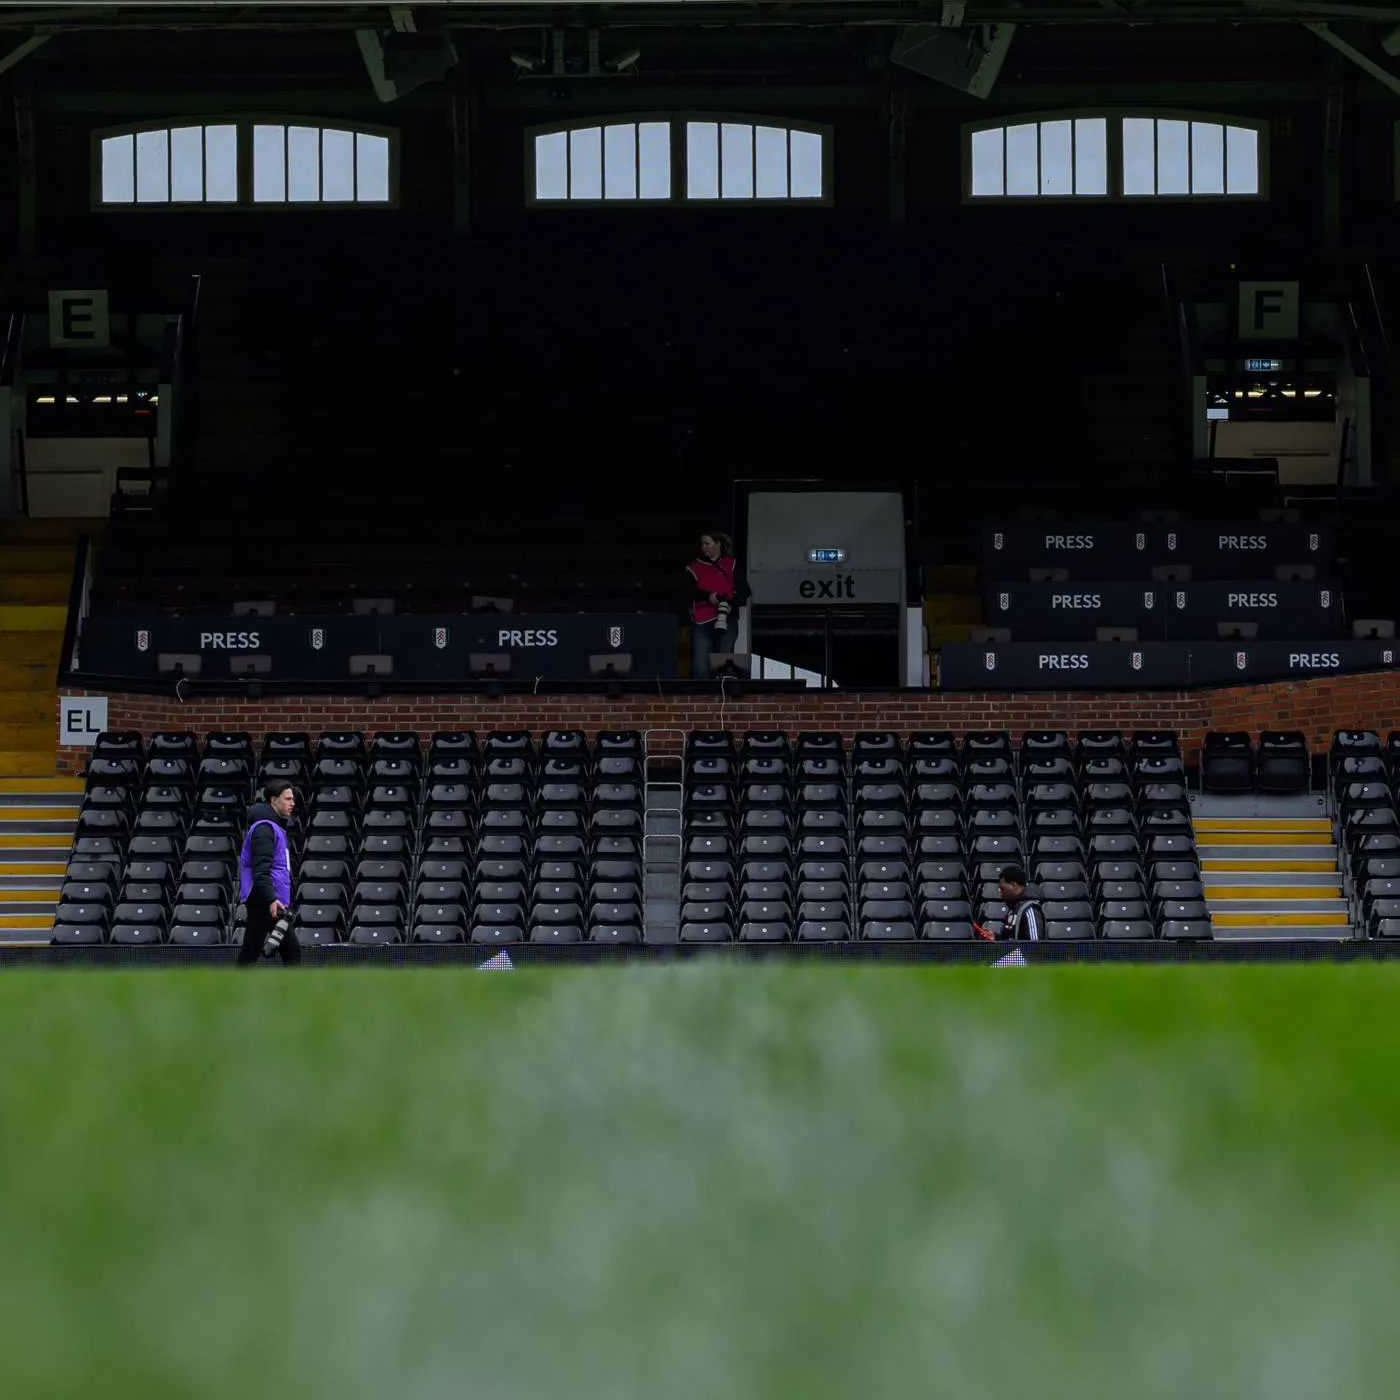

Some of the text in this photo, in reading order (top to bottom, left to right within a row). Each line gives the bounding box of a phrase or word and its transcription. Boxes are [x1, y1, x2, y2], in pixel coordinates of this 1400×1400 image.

[1254, 290, 1283, 330] F
[62, 298, 95, 339] E
[1045, 535, 1094, 549] PRESS
[1218, 535, 1268, 550] PRESS
[800, 574, 855, 599] exit
[1052, 594, 1102, 609] PRESS
[1228, 593, 1278, 608] PRESS
[200, 631, 260, 649] PRESS
[498, 629, 558, 647] PRESS
[1038, 654, 1089, 669] PRESS
[1289, 653, 1340, 668] PRESS
[67, 709, 100, 732] EL
